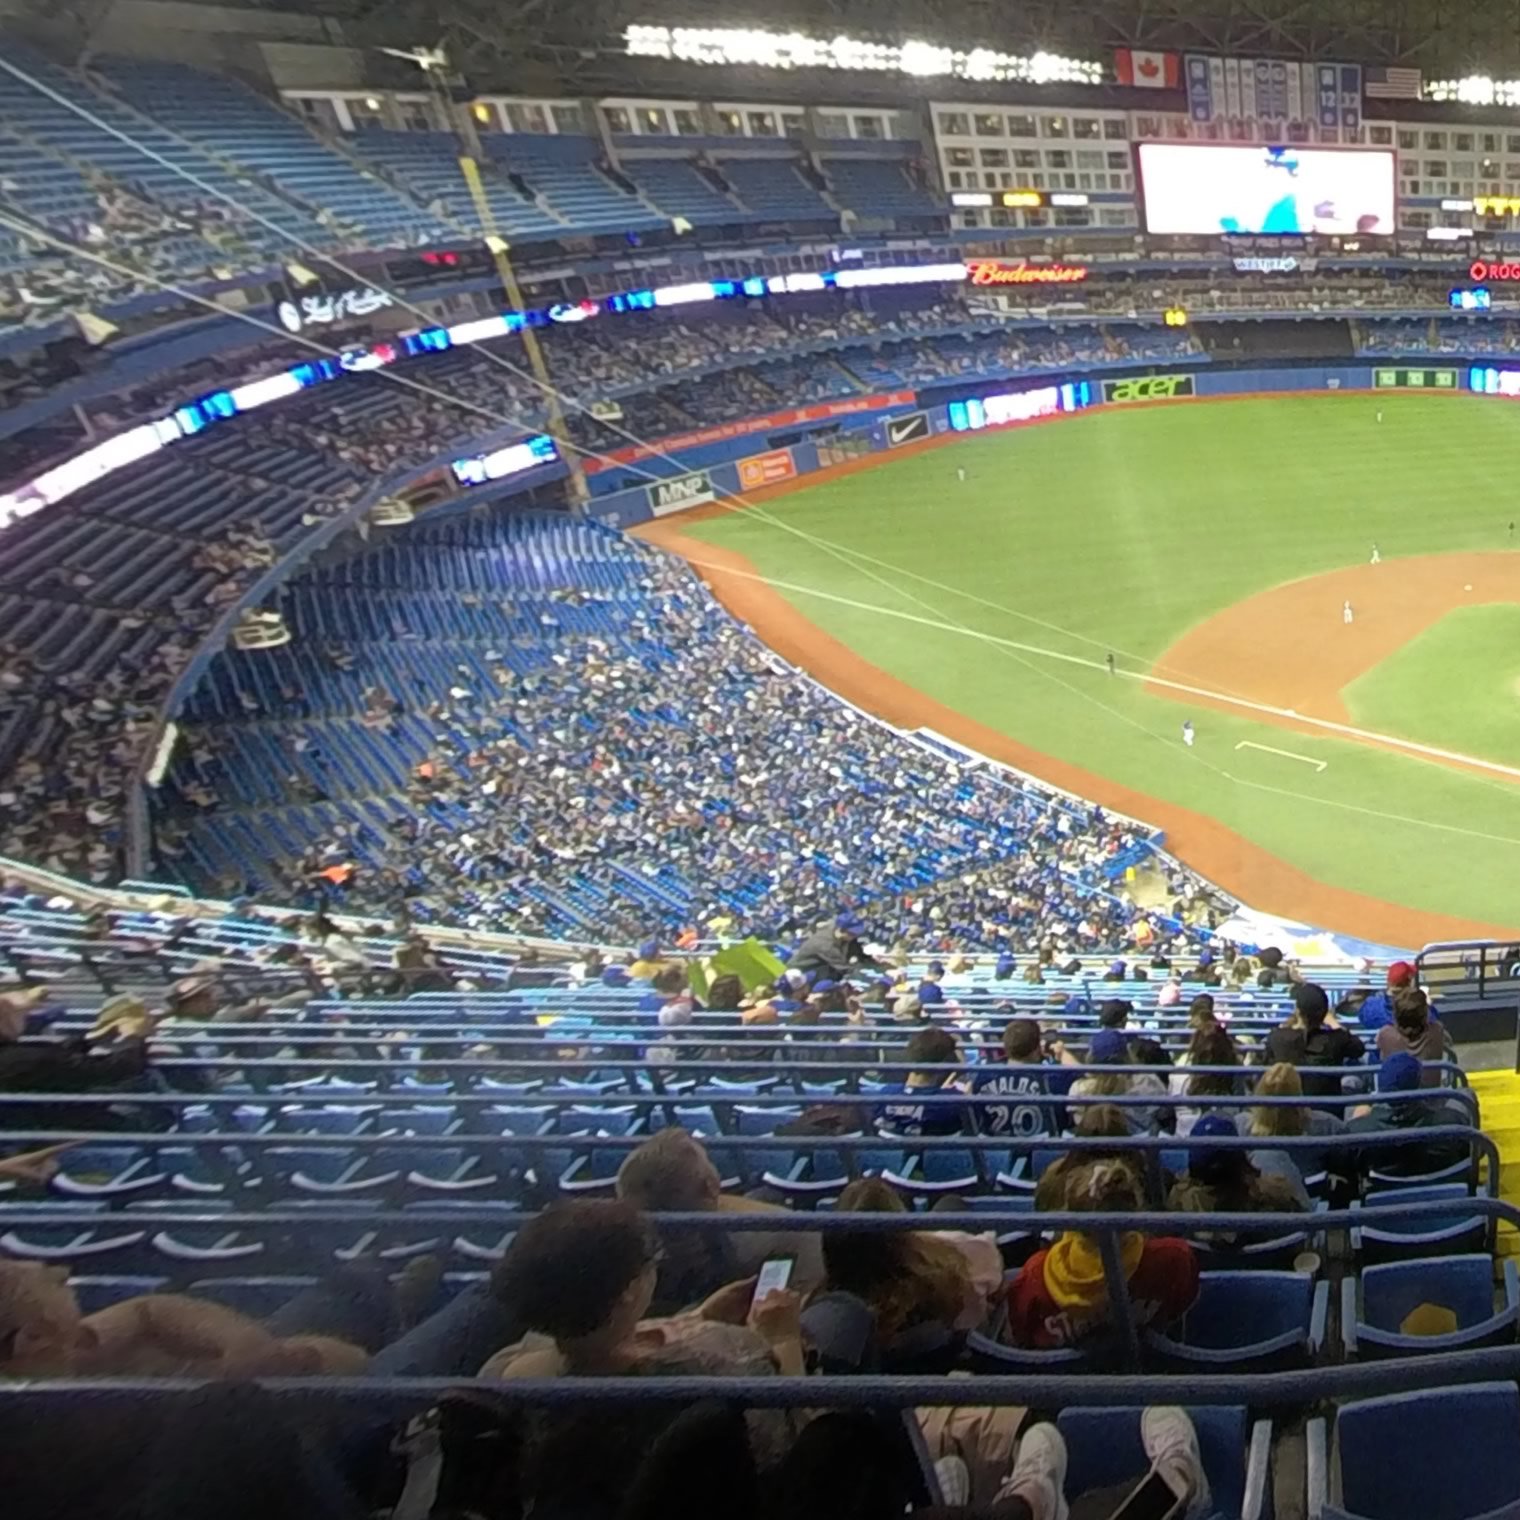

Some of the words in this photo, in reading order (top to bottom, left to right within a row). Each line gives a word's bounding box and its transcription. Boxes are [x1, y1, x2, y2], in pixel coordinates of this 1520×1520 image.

[1320, 91, 1336, 107] 12
[966, 262, 1087, 285] Budweiser
[1111, 374, 1185, 401] acer
[658, 477, 703, 506] MNP
[984, 1104, 1043, 1136] 20
